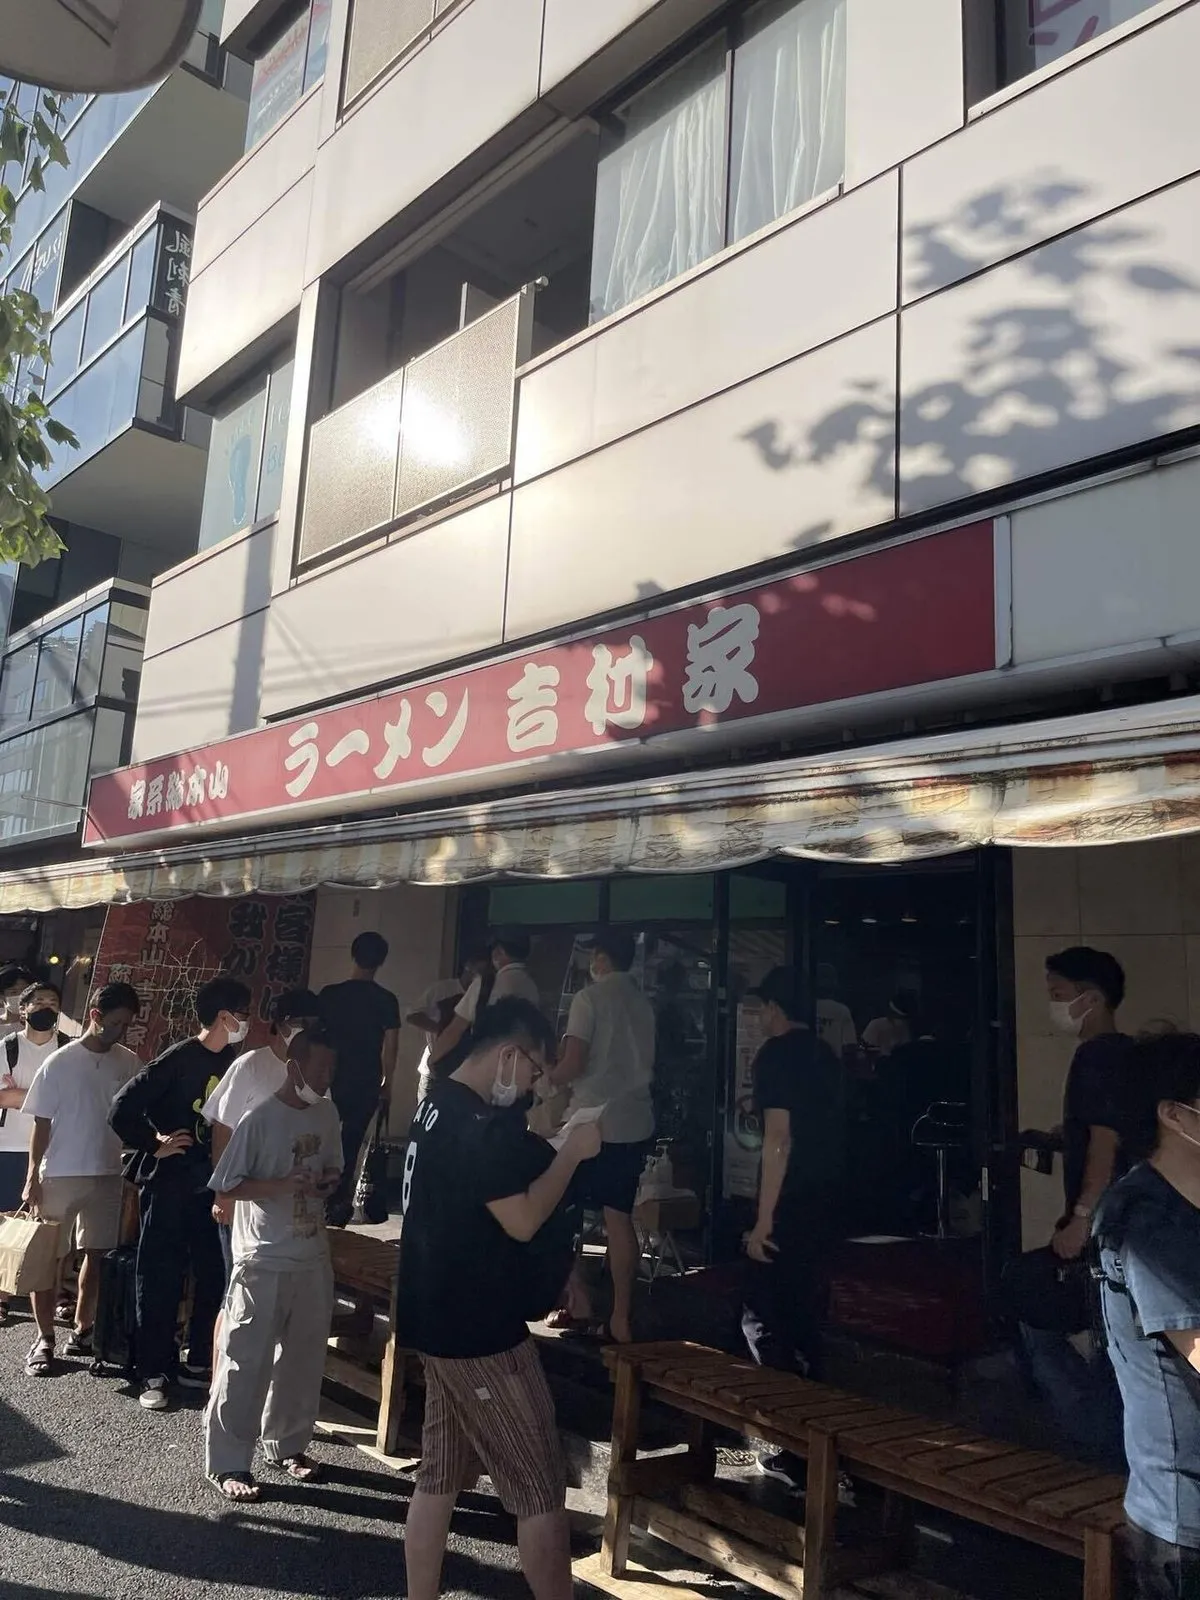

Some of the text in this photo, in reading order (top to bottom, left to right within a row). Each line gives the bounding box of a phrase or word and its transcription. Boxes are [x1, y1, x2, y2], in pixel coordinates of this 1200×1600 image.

[284, 687, 469, 798] ラーメン
[504, 603, 761, 753] 吉村家
